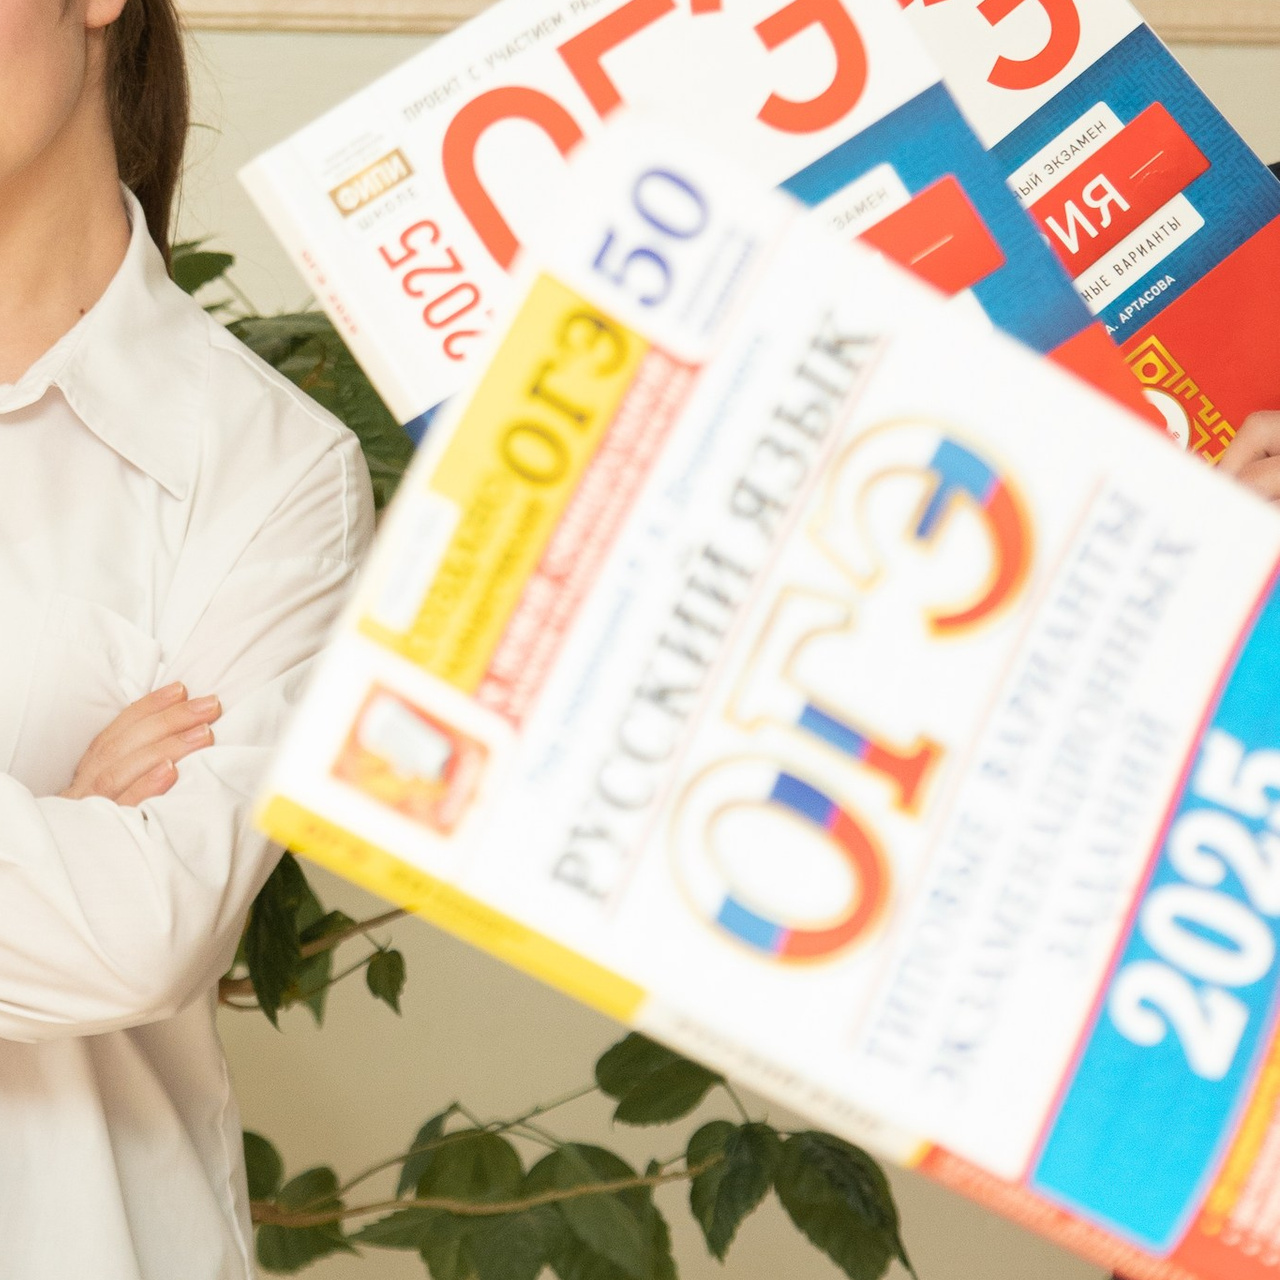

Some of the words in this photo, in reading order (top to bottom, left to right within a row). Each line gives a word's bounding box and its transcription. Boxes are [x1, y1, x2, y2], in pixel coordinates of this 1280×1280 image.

[1043, 120, 1107, 176] ЭКЗАМЕН
[591, 168, 709, 309] 50
[832, 187, 889, 231] ЗАМЕН
[1042, 173, 1131, 255] ИЯ
[1113, 216, 1182, 276] ВАРИАНТЫ
[1120, 273, 1176, 324] АРТАСОВА
[501, 307, 630, 487] ОГЭ
[552, 540, 758, 901] РУССКИЙ
[729, 313, 882, 542] ЯЗЫК
[667, 416, 1039, 966] ОГЭ
[1108, 726, 1280, 1082] 2025
